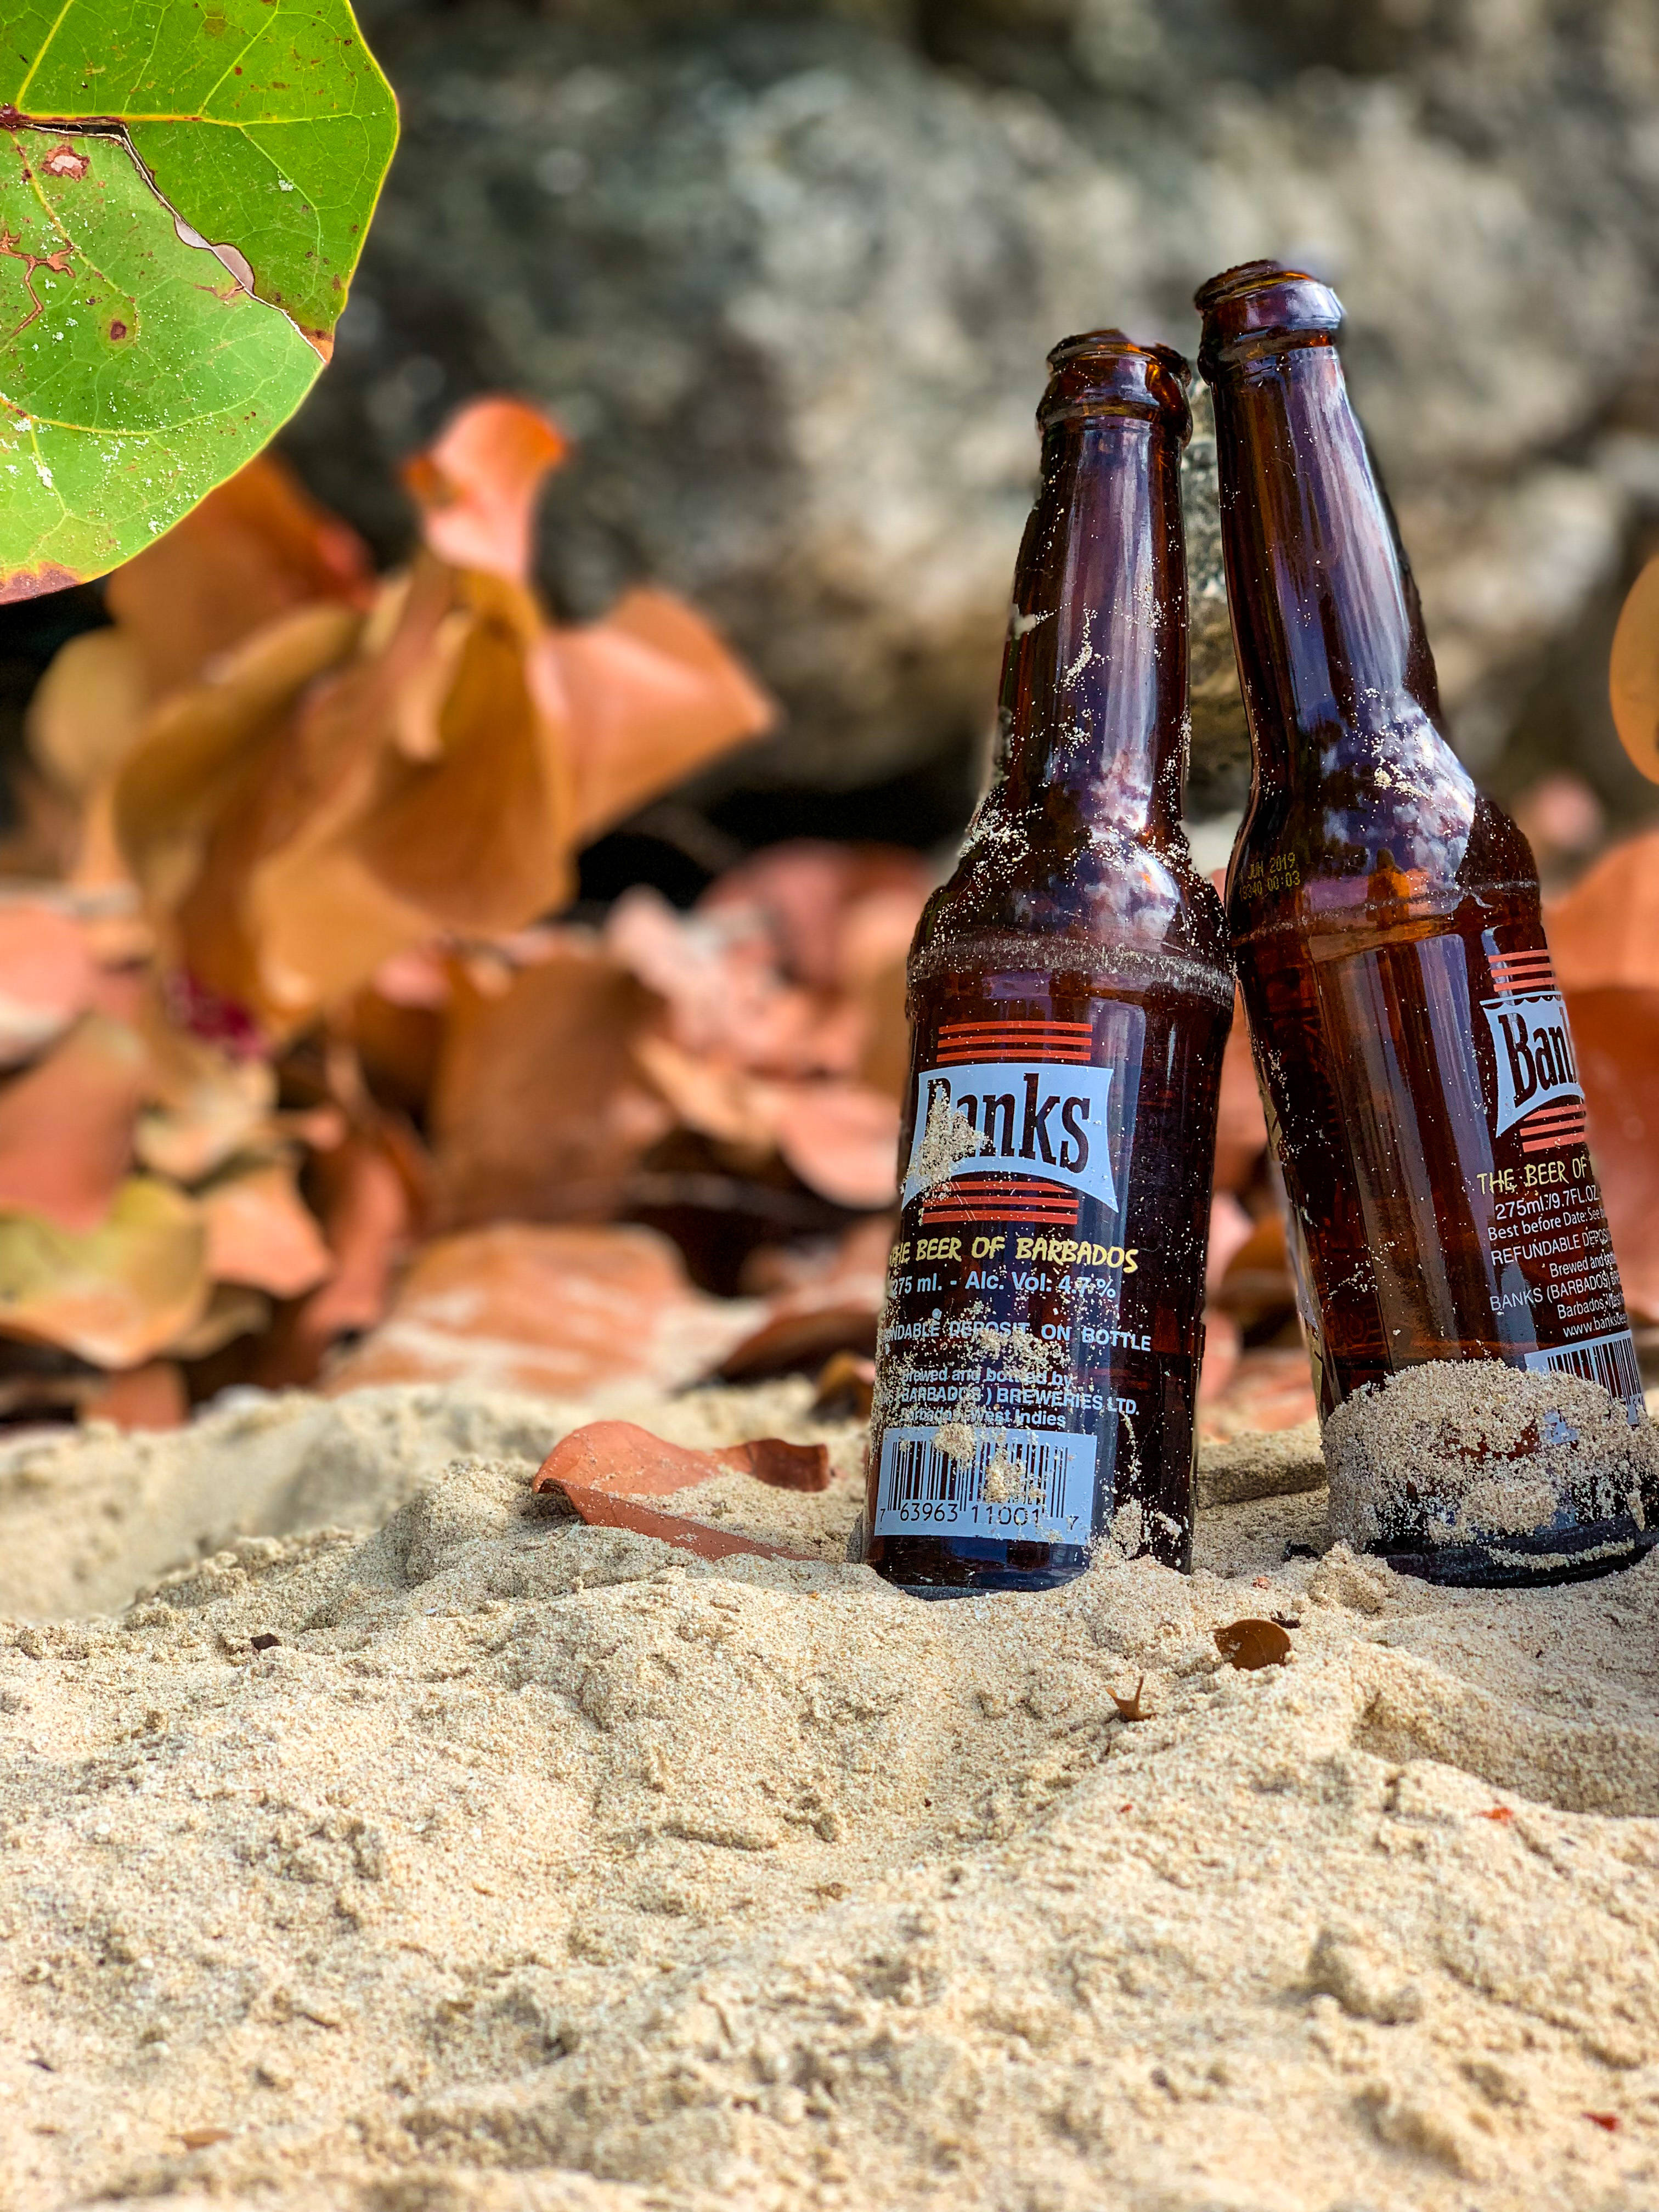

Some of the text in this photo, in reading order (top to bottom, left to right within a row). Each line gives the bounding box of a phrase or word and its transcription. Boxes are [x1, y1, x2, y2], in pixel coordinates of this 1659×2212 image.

[1269, 852, 1295, 873] 2019
[1267, 870, 1300, 891] 00:03
[1476, 1155, 1587, 1195] THE BEER OF
[1487, 1224, 1520, 1241] Best
[1521, 1213, 1561, 1234] before
[1562, 1211, 1588, 1226] Date:
[1587, 1206, 1600, 1221] See
[915, 1237, 962, 1262] BEER
[971, 1236, 1006, 1259] OF
[1015, 1237, 1139, 1273] BARBADOS
[1491, 1234, 1581, 1266] REFUNDABLE
[1581, 1228, 1612, 1247] DEPOS
[1549, 1256, 1589, 1278] Brewed
[1590, 1254, 1605, 1269] and
[917, 1273, 942, 1293] ml.
[964, 1271, 1005, 1290] Alc.
[1489, 1287, 1543, 1311] BANKS
[1547, 1272, 1611, 1304] (BARBADOS)
[1041, 1324, 1070, 1340] ON
[1082, 1327, 1152, 1351] BOTTLE
[996, 1387, 1103, 1411] BREWERIES
[1107, 1397, 1139, 1415] LTD.
[1015, 1409, 1066, 1427] Indies
[881, 1509, 885, 1522] 7
[899, 1503, 958, 1522] 63963
[971, 1505, 1040, 1526] 11001
